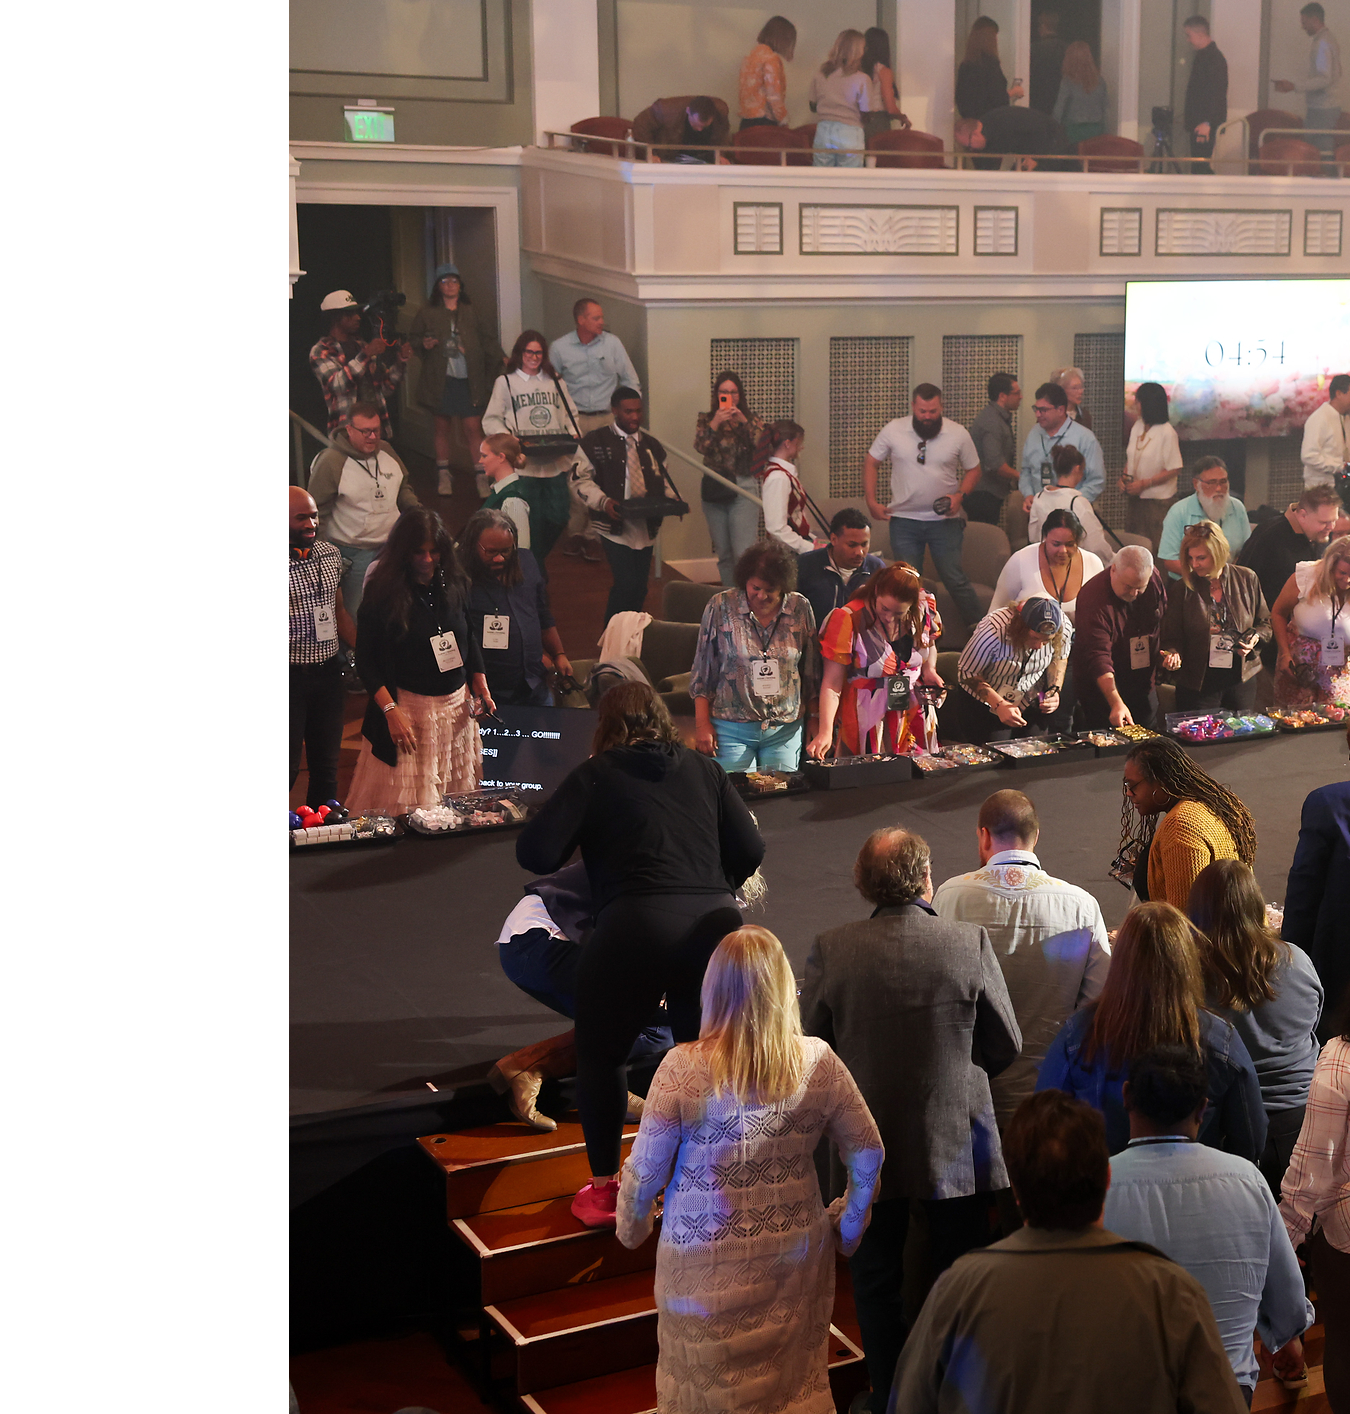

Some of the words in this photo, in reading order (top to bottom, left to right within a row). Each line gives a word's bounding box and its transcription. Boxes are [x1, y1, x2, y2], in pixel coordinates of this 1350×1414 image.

[354, 115, 386, 139] EXIT
[1204, 339, 1285, 369] 04:54
[511, 391, 560, 411] MEMORIA
[521, 782, 543, 791] group.
